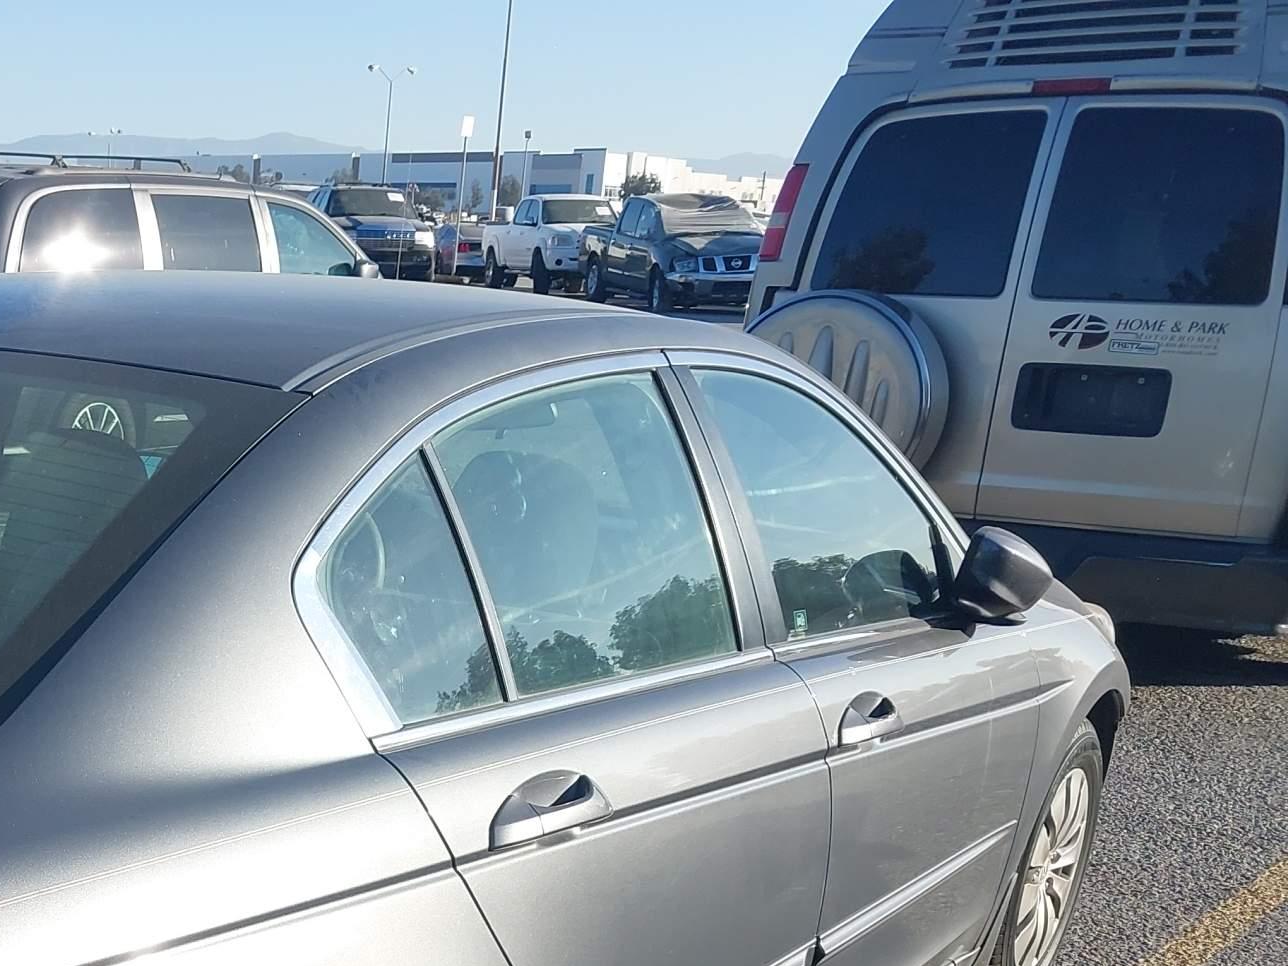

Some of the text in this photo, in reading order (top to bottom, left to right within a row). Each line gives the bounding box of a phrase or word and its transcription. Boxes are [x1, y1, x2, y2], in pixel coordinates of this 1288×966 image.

[1114, 318, 1231, 335] HOME & PARK
